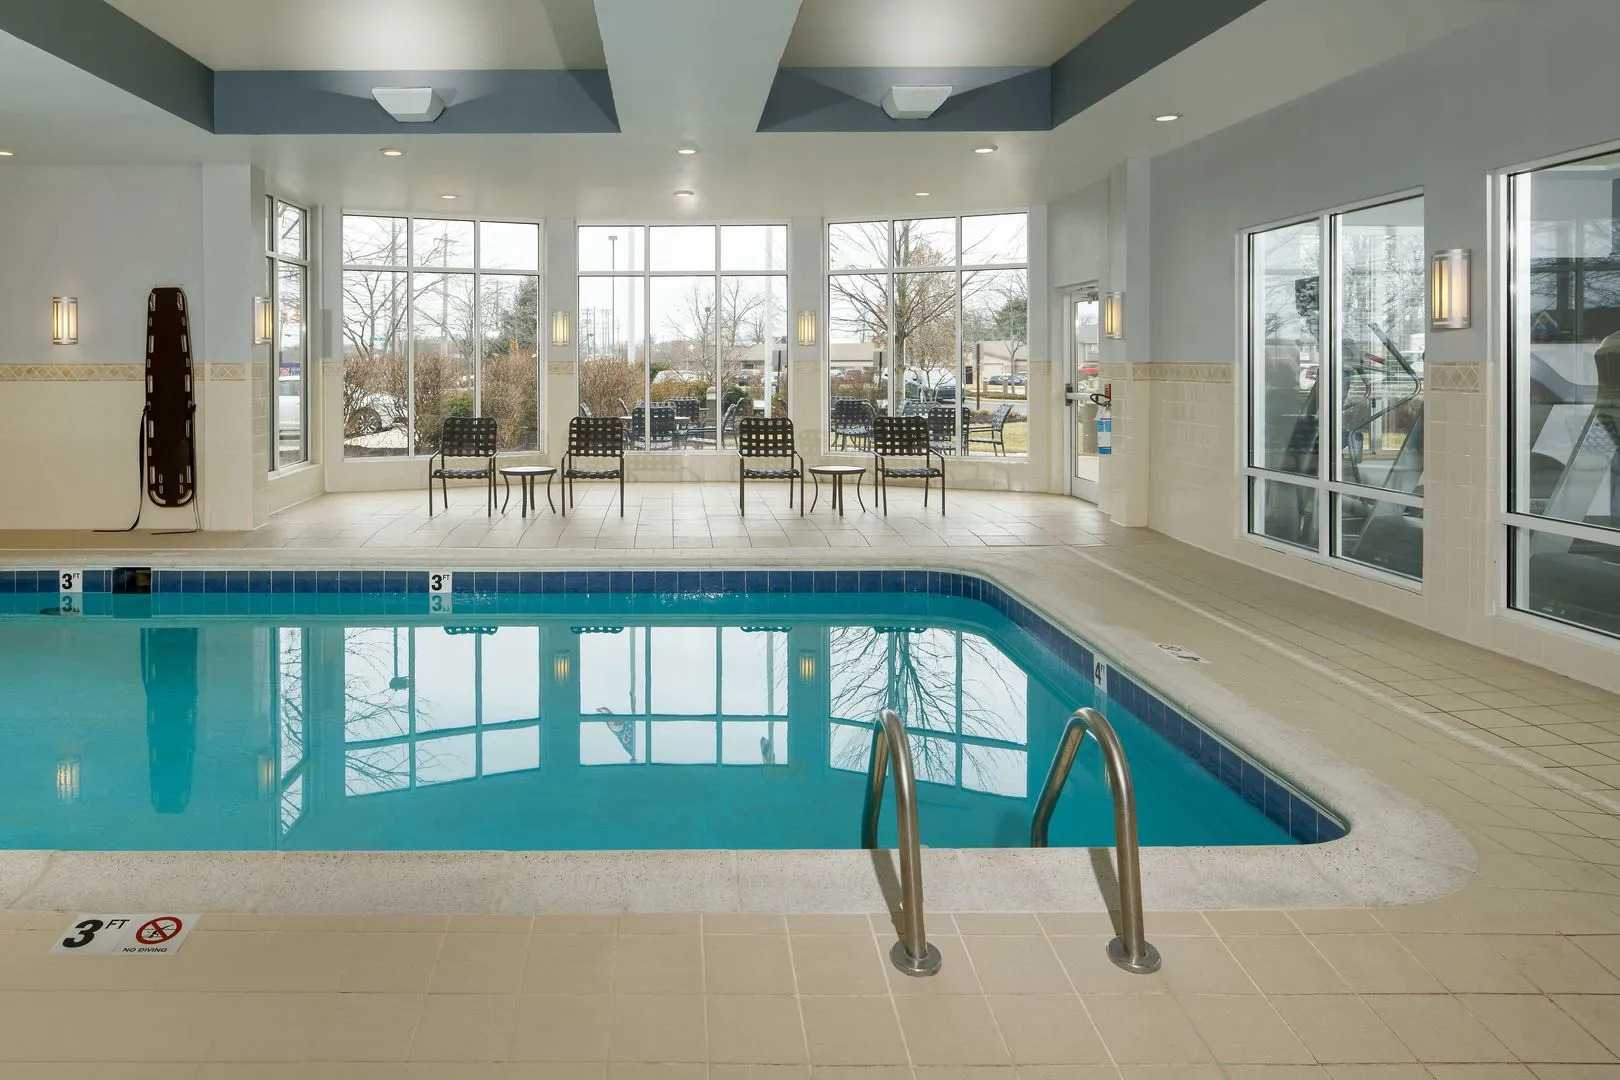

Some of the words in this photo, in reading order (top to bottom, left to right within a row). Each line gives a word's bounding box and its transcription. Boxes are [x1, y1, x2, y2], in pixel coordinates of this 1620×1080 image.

[62, 573, 72, 590] 3
[431, 575, 442, 591] 3
[1095, 661, 1102, 685] 4
[62, 919, 104, 948] 3
[105, 919, 131, 930] FT
